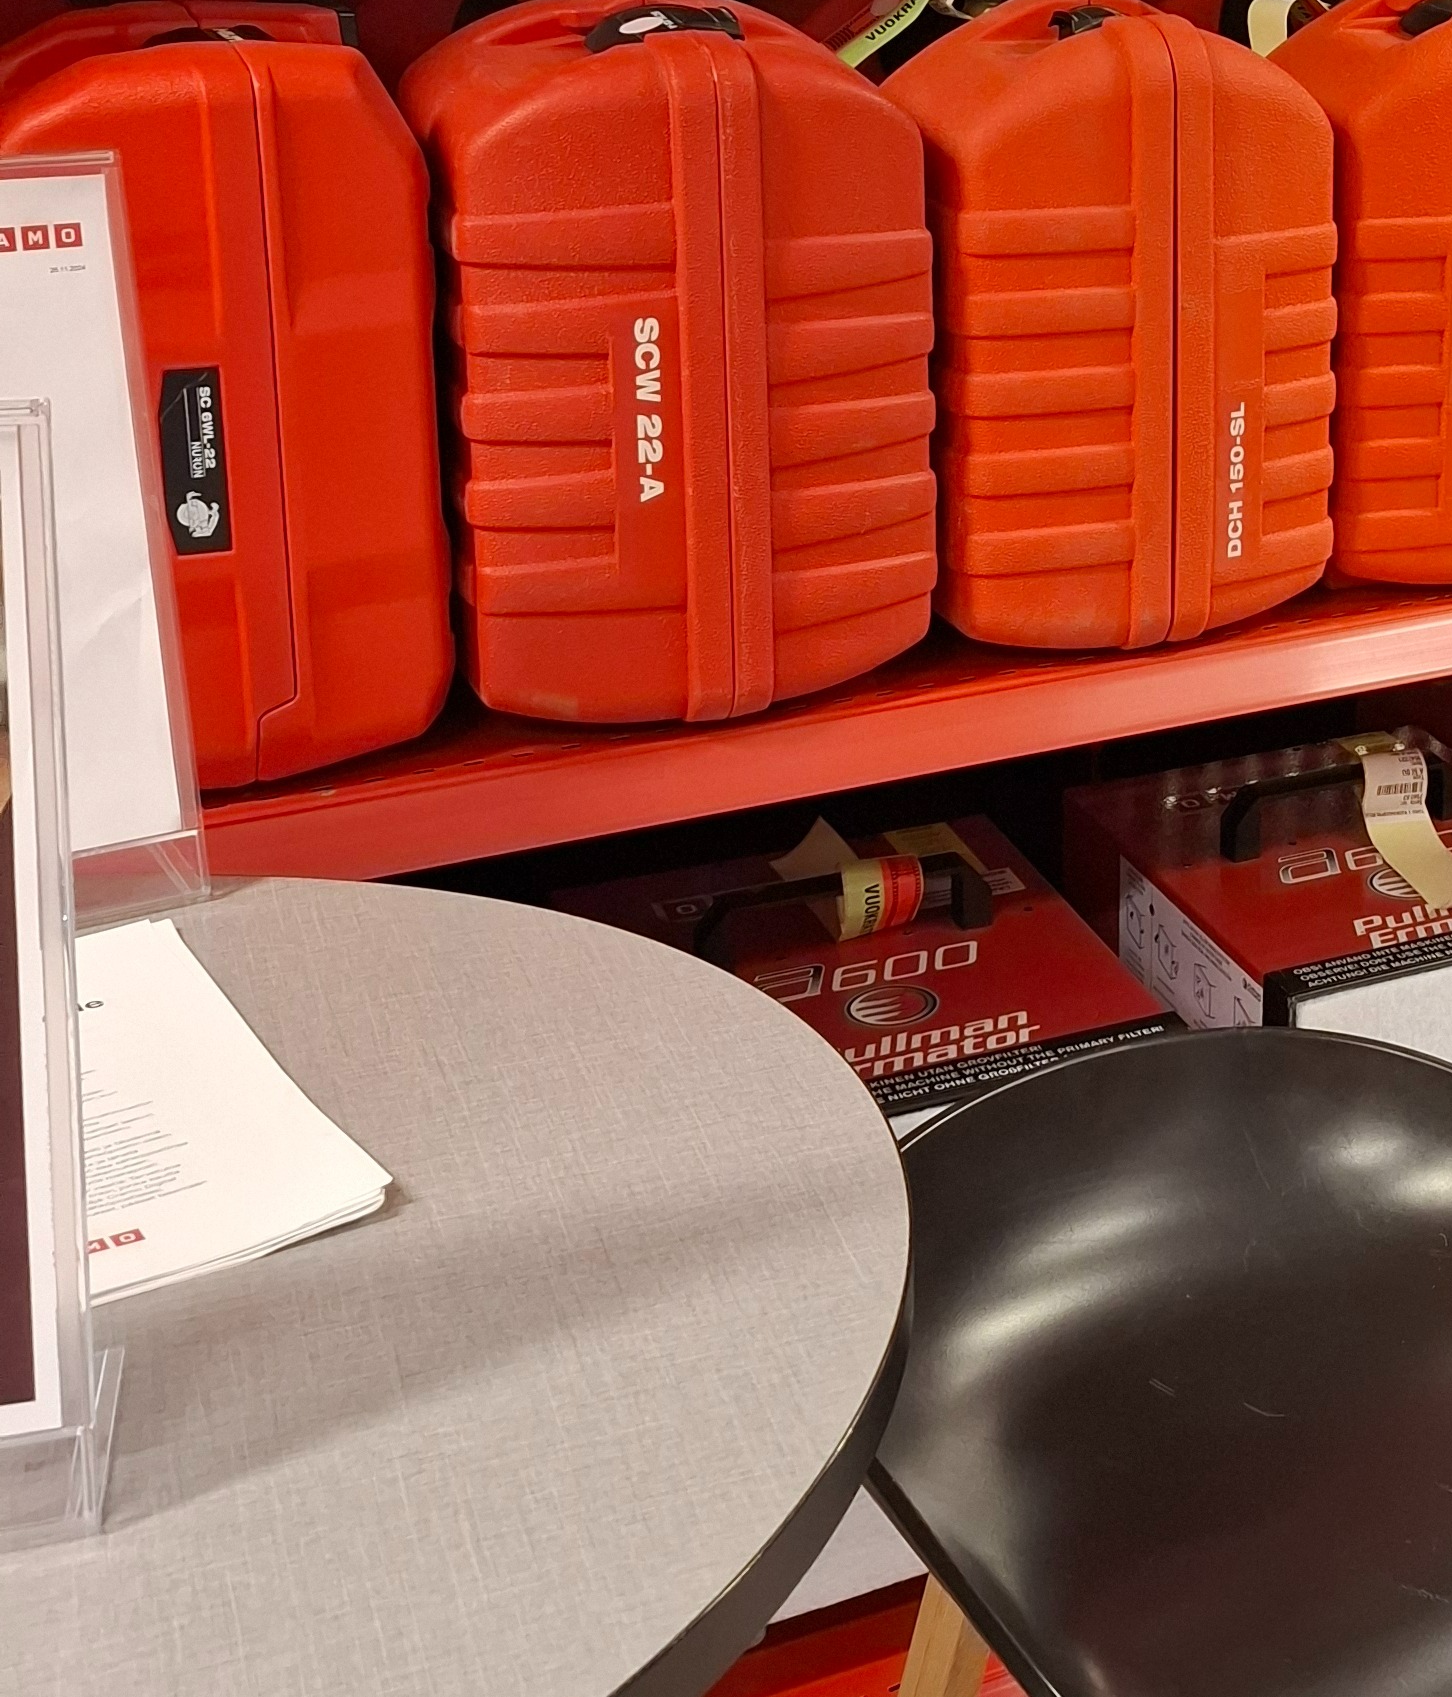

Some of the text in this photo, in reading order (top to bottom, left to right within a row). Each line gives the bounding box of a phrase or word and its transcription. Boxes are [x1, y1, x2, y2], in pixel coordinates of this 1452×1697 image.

[199, 386, 212, 409] SC
[633, 316, 665, 503] SCW 22-A
[191, 441, 205, 479] NURON
[1227, 401, 1246, 558] DCH 150-SL
[1293, 963, 1323, 975] OBS!
[1372, 947, 1399, 958] INTE
[1300, 963, 1360, 982] OBSERVE!
[1396, 948, 1423, 960] USE
[1422, 943, 1446, 954] THE
[1307, 969, 1368, 988] ACHTUNG!
[1369, 962, 1390, 974] DIE
[1391, 950, 1445, 968] MACHINE
[836, 1010, 1028, 1062] ullman
[853, 1024, 1041, 1077] rmator
[895, 1072, 961, 1092] MACHINE
[962, 1058, 1026, 1077] WITHOUT
[1026, 1050, 1056, 1062] THE
[1057, 1036, 1116, 1055] PRIMARY
[1117, 1025, 1165, 1041] FILTER!
[917, 1064, 953, 1078] UTAN
[957, 1044, 1043, 1069] GROVFILTER!
[888, 1085, 932, 1102] NICHT
[933, 1075, 977, 1091] OHNE
